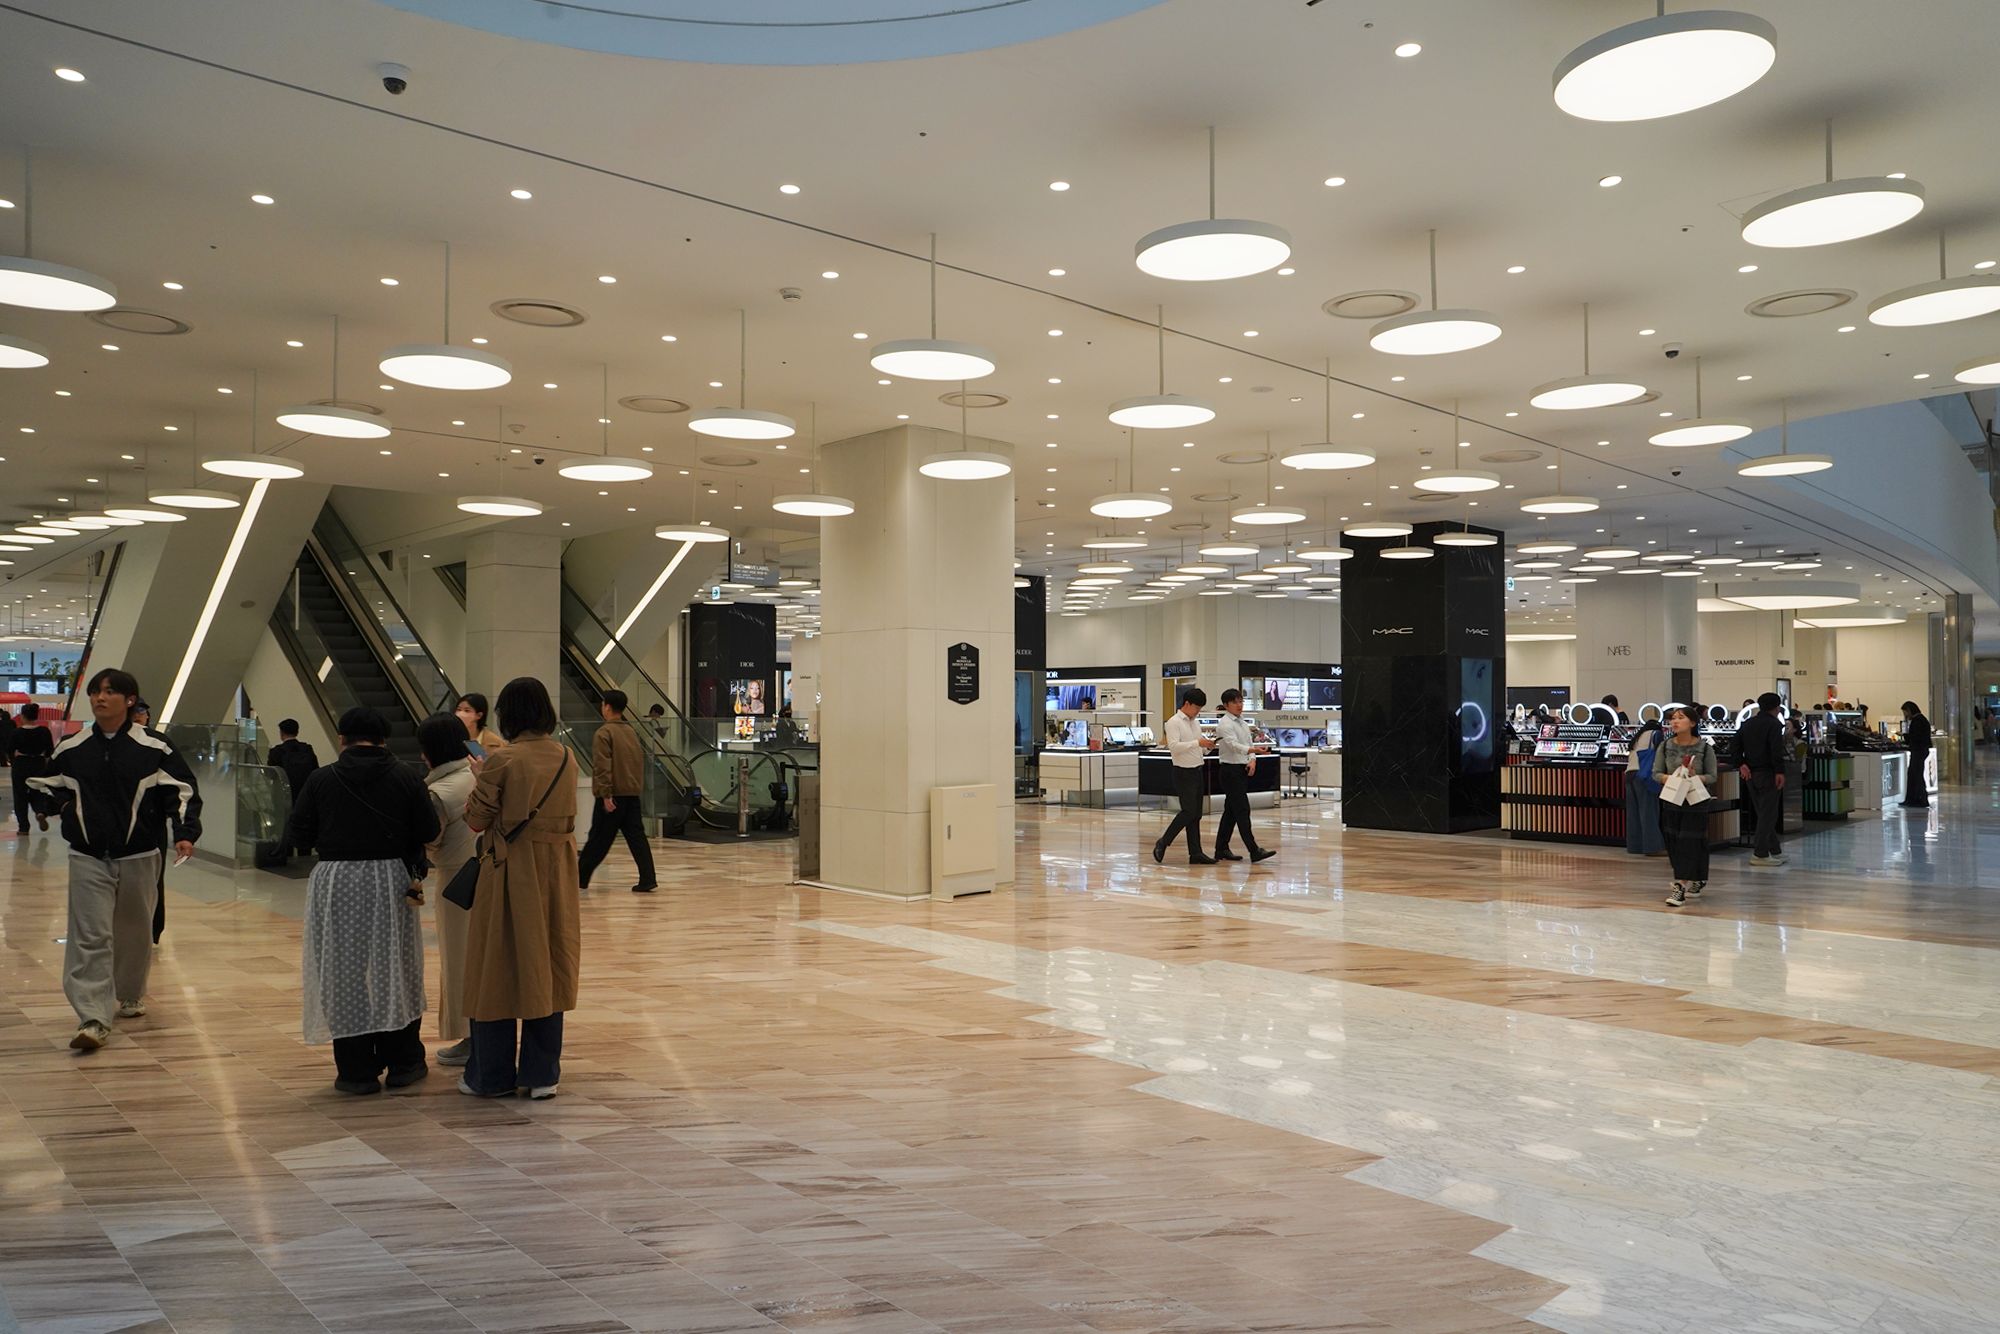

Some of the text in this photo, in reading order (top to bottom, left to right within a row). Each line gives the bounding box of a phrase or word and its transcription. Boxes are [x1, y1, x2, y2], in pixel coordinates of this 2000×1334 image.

[735, 542, 741, 555] 1
[1372, 627, 1414, 636] MAC
[1465, 627, 1489, 636] MAC
[1607, 645, 1632, 656] NARS
[1714, 659, 1756, 667] TAMBURINS
[1046, 671, 1058, 679] IOR
